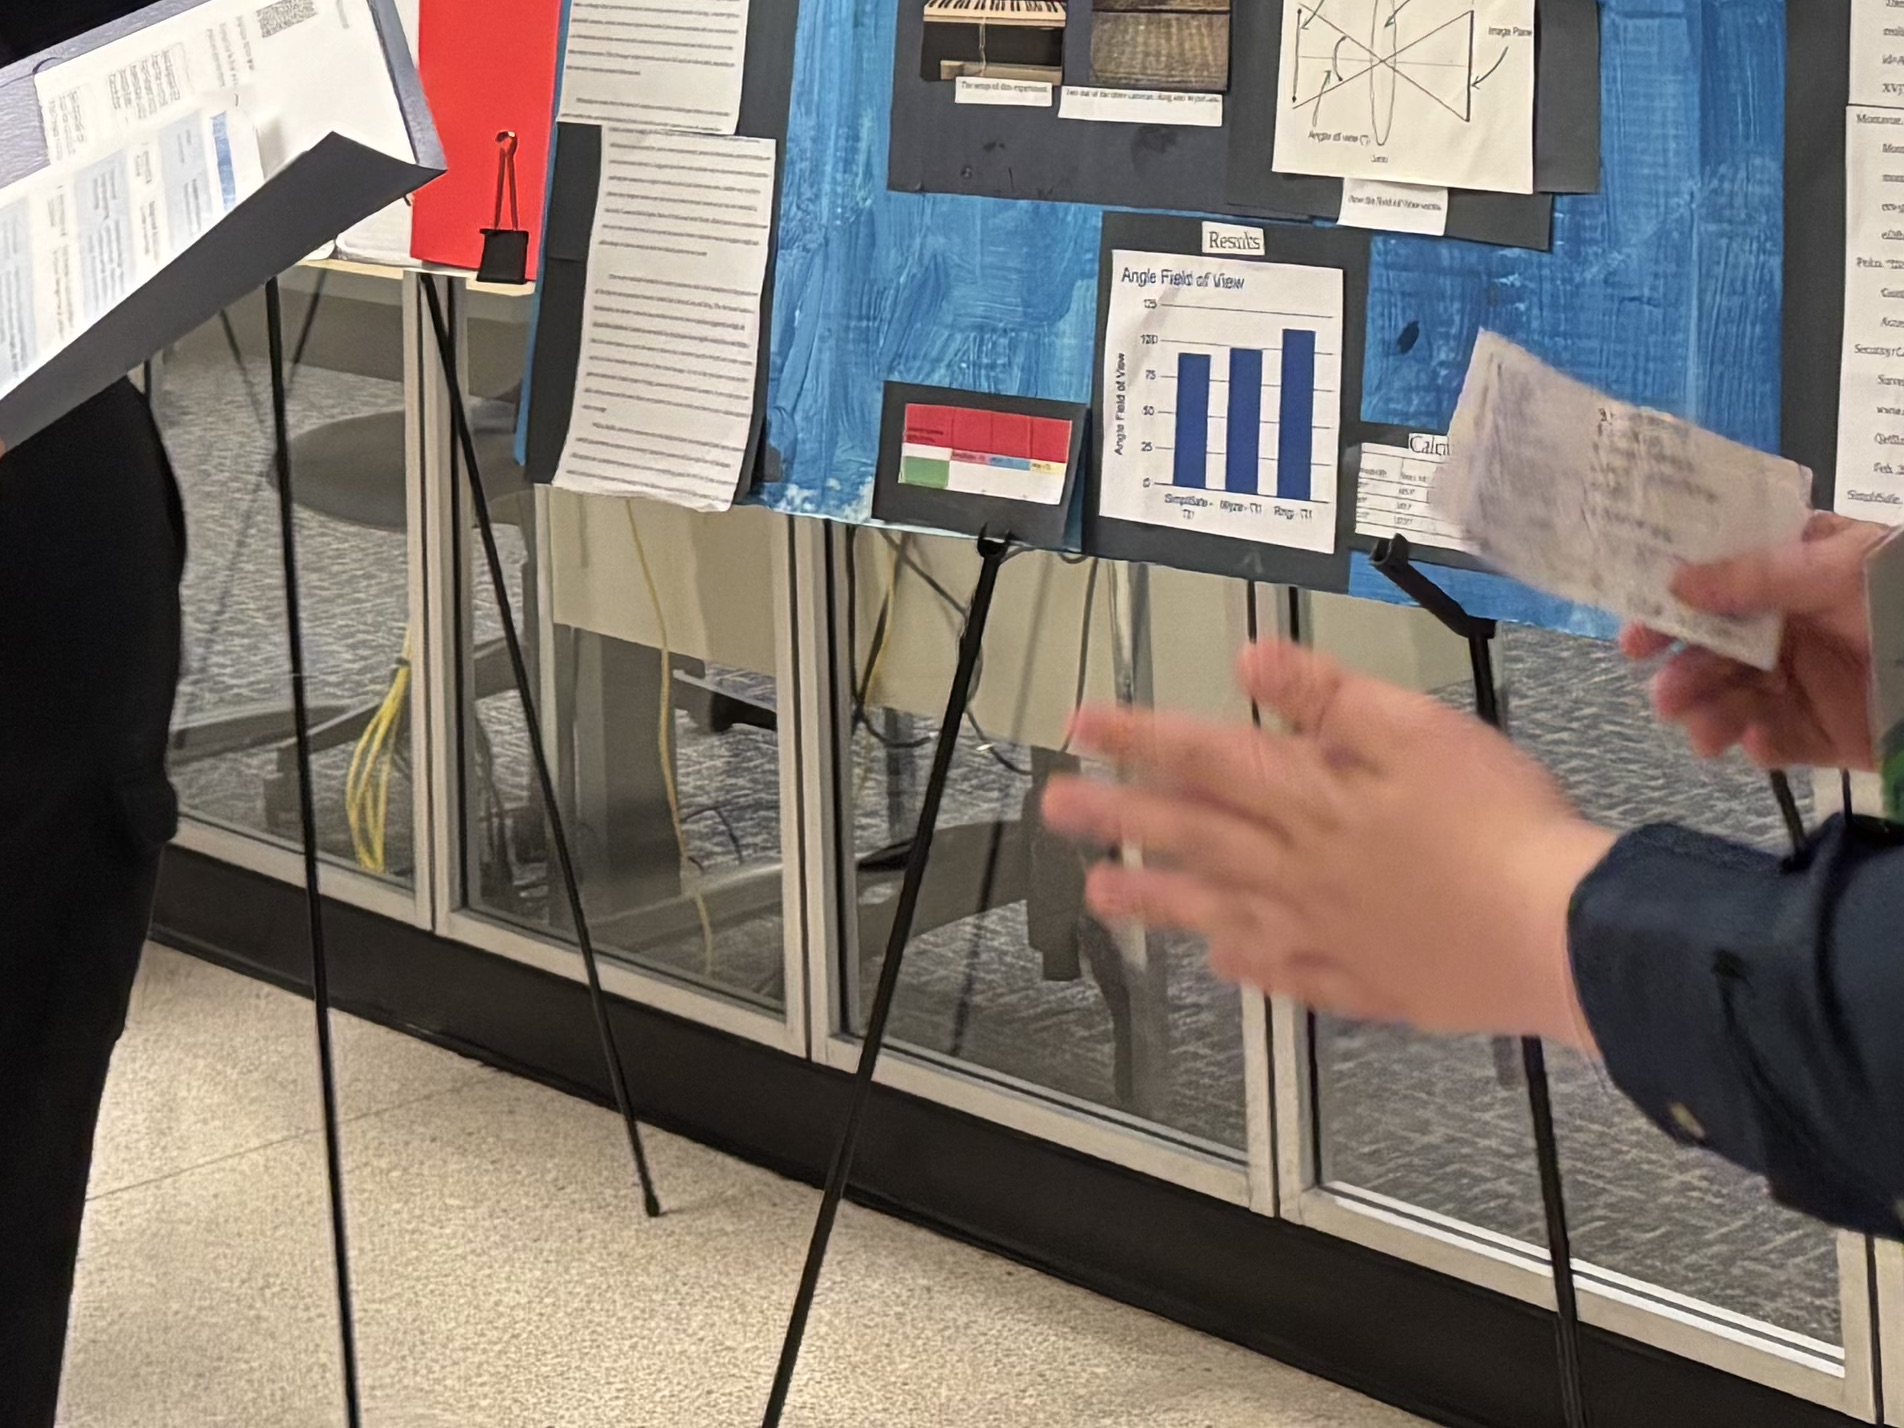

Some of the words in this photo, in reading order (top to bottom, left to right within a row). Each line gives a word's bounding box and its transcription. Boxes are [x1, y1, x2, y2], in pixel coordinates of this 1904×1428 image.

[1209, 231, 1260, 250] Results
[1121, 267, 1156, 288] Angle
[1161, 270, 1193, 286] Field
[1196, 275, 1210, 288] of
[1214, 273, 1245, 290] View
[1118, 353, 1126, 377] View
[1118, 380, 1126, 392] of
[1116, 395, 1125, 420] Field
[1115, 422, 1124, 455] Angle
